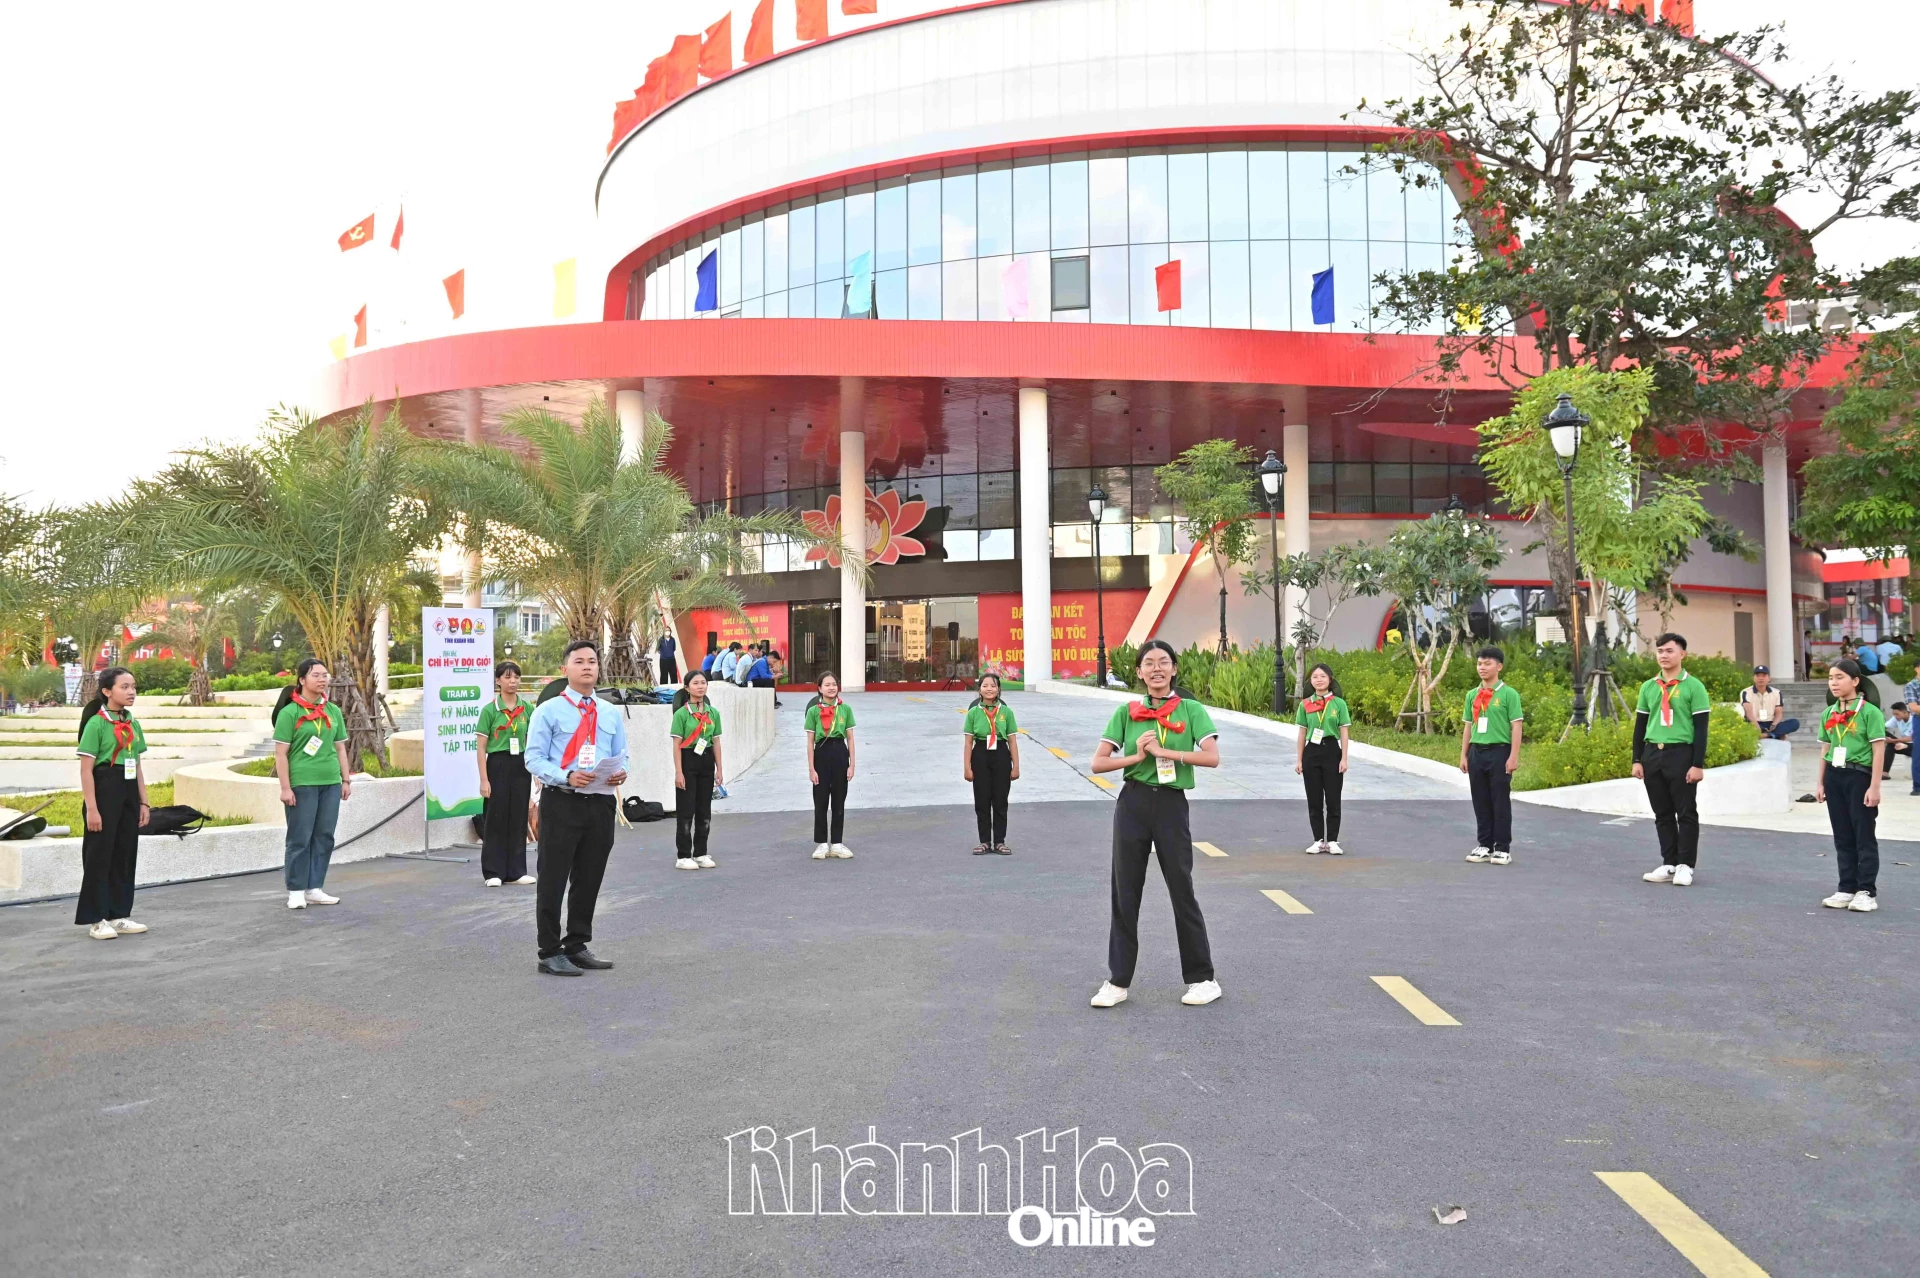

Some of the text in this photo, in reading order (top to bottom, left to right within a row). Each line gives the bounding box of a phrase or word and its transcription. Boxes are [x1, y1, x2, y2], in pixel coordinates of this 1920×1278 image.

[1064, 600, 1084, 618] KẾT
[1066, 624, 1086, 642] TỘC
[428, 656, 441, 667] CHỈ
[990, 648, 1003, 662] LÀ
[1063, 646, 1077, 661] VÔ
[446, 689, 475, 699] TRẠM 5
[441, 705, 479, 719] KỸ NĂNG
[437, 724, 457, 737] SINH
[443, 739, 460, 756] TẬP
